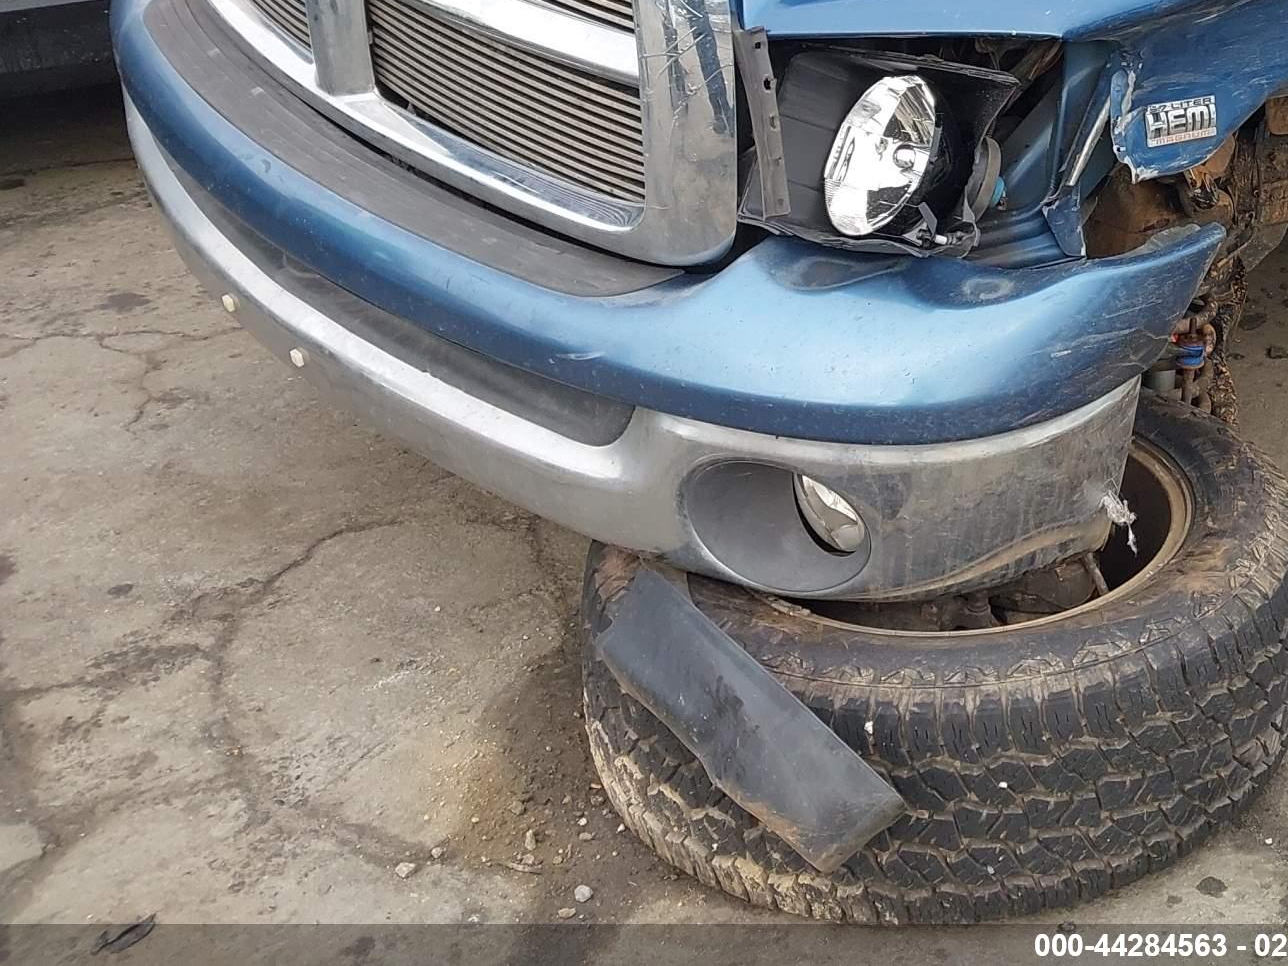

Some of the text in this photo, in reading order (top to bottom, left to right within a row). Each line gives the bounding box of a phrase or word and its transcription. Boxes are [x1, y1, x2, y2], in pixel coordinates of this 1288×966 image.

[1170, 97, 1212, 110] LITER
[1145, 103, 1217, 140] HEMI
[1155, 130, 1211, 145] MAGNUM
